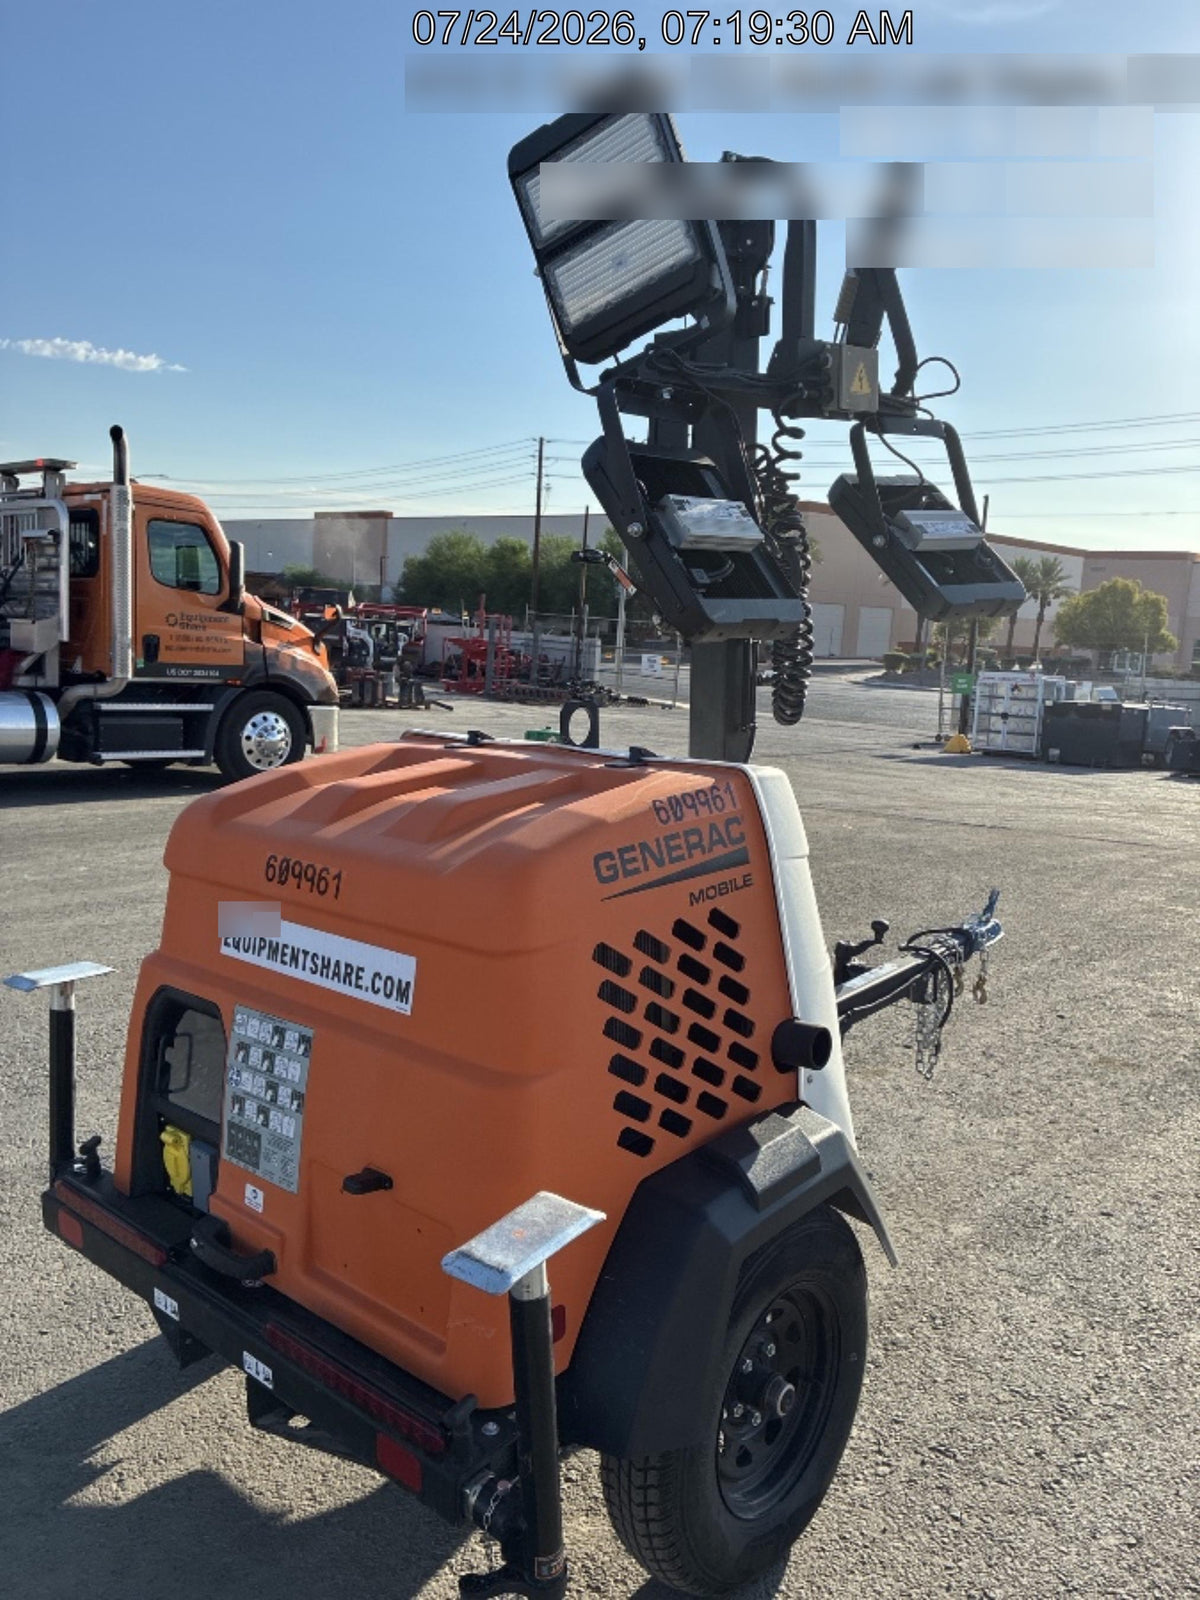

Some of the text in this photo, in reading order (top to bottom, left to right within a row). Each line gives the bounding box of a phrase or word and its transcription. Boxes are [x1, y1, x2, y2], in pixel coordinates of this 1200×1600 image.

[652, 782, 738, 825] 609961
[593, 816, 746, 884] GENERAC
[265, 854, 343, 899] 609961
[689, 873, 754, 907] MOBILE
